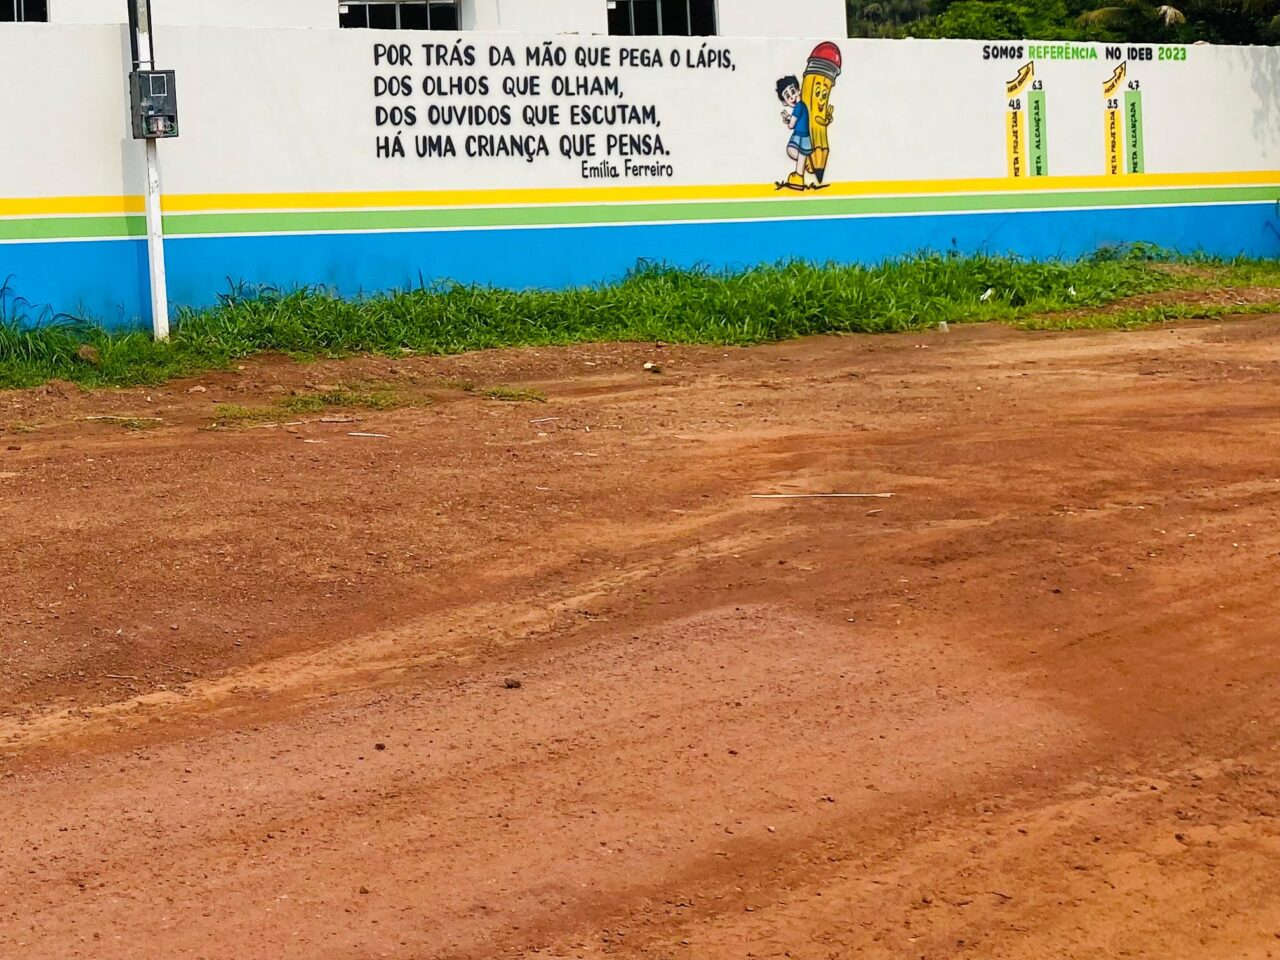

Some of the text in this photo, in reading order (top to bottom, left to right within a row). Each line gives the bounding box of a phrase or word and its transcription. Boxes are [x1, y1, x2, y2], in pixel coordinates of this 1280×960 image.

[373, 38, 736, 71] POR TRÁS DA MÃO QUE PEGA O LÁPIS,
[982, 43, 1187, 61] SOMOS REFERÊNCIA NO IDEB 2023
[373, 75, 624, 99] DOS OLHOS QUE OLHAM,
[375, 104, 661, 128] DOS OUVIDOS QUE ESCUTAM,
[1129, 101, 1137, 149] ALCANÇADA
[375, 130, 671, 163] HÁ UMA CRIANÇA QUE PENSA.
[581, 158, 673, 179] Emília Ferreiro
